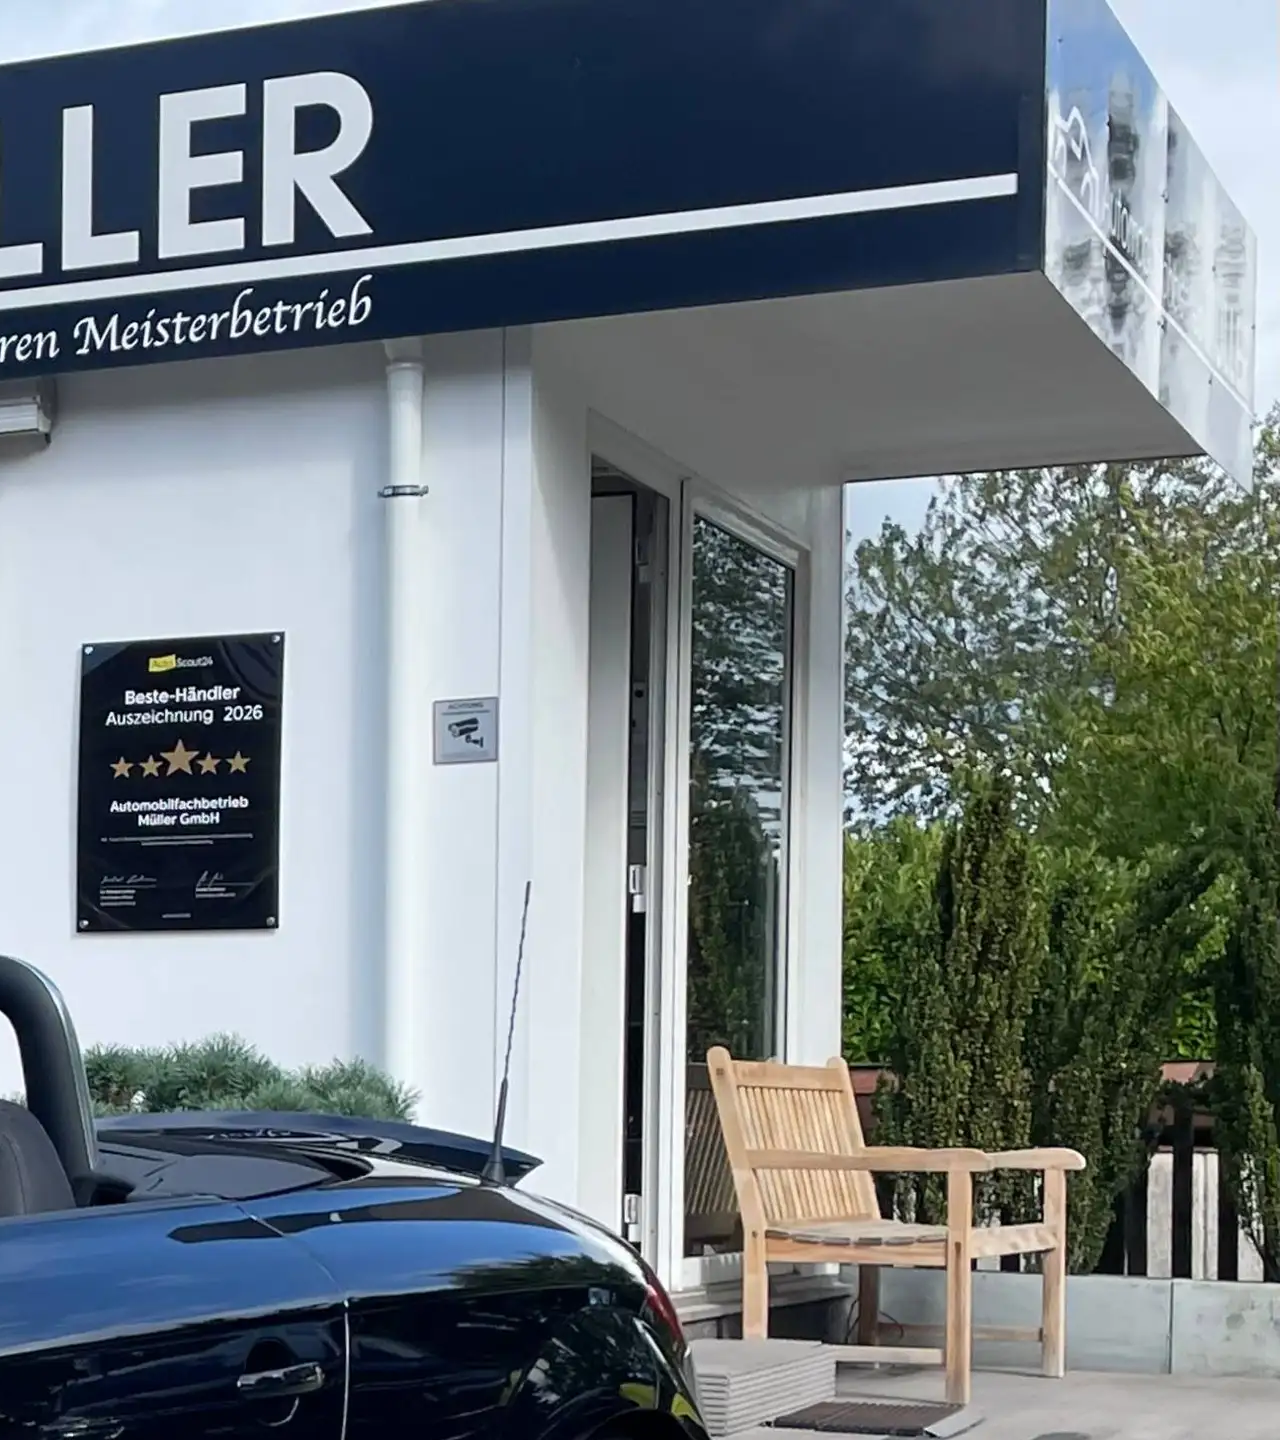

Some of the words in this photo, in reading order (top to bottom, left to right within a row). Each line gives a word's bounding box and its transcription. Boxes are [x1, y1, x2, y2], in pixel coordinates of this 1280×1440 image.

[73, 274, 373, 355] Meisterbetrieb
[150, 654, 214, 671] Scout24
[124, 686, 240, 706] Beste-Händler
[105, 706, 215, 727] Auszeichnung
[223, 704, 264, 722] 2026
[109, 795, 250, 813] Automobilfachbetrieb
[137, 812, 177, 827] Müller
[179, 811, 220, 826] GmbH
